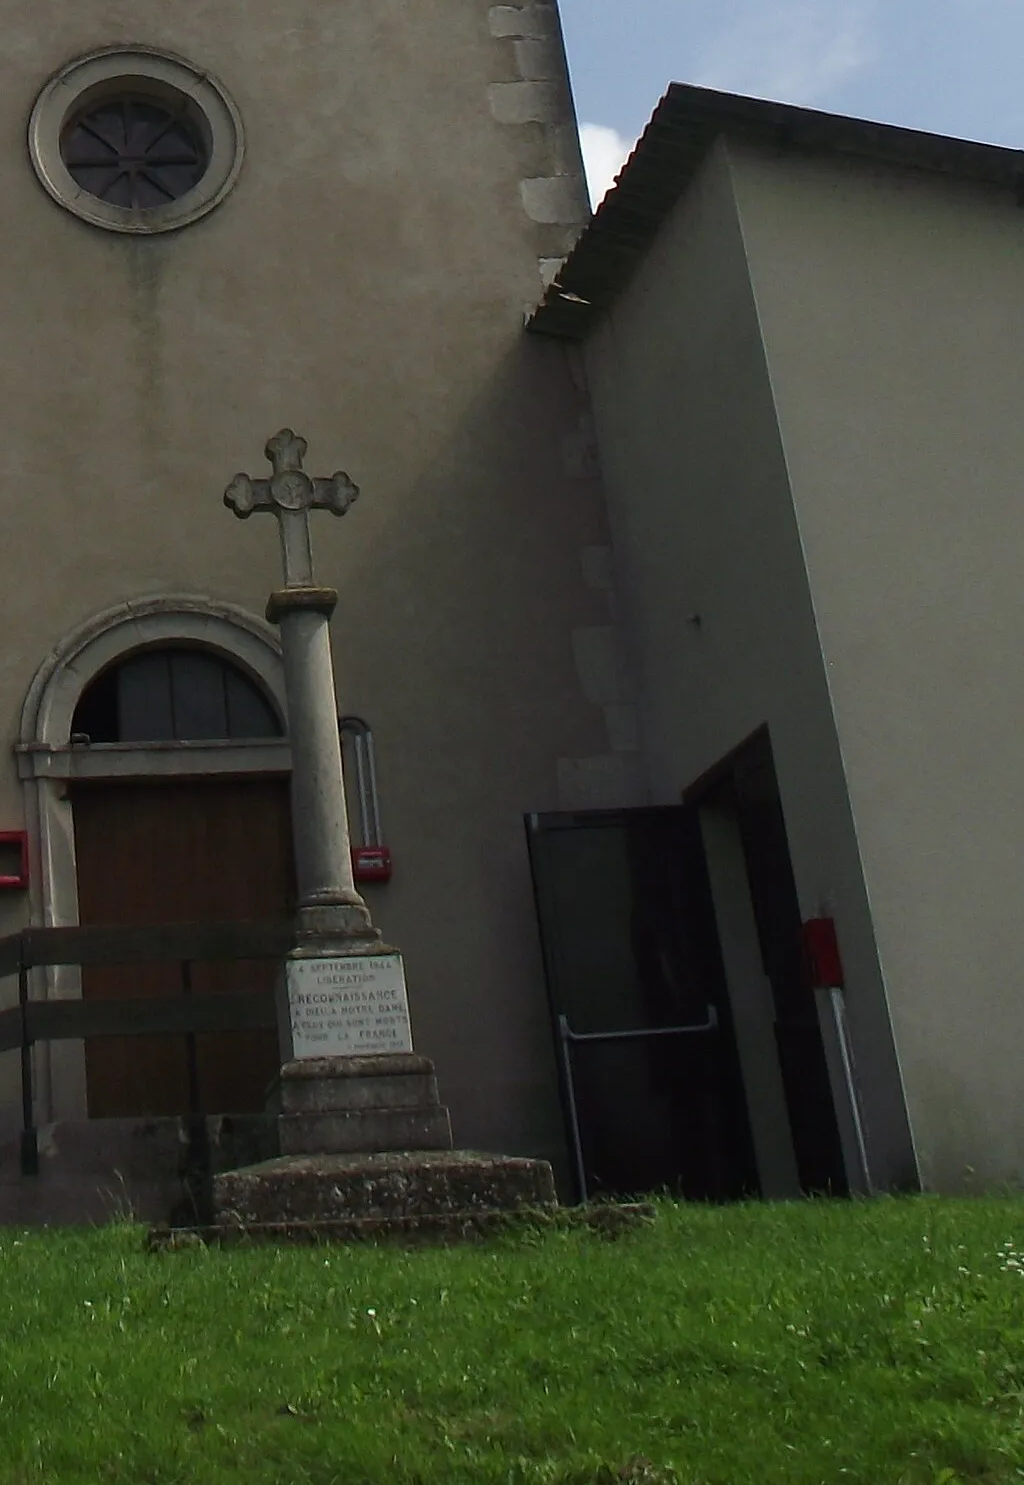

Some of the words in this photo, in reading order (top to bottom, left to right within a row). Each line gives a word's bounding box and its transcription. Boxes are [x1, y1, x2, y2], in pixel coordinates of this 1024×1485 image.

[311, 962, 363, 973] SEPTEMBRE
[298, 989, 397, 1004] RECONNAISSANCE
[359, 1029, 398, 1039] FRANCE
